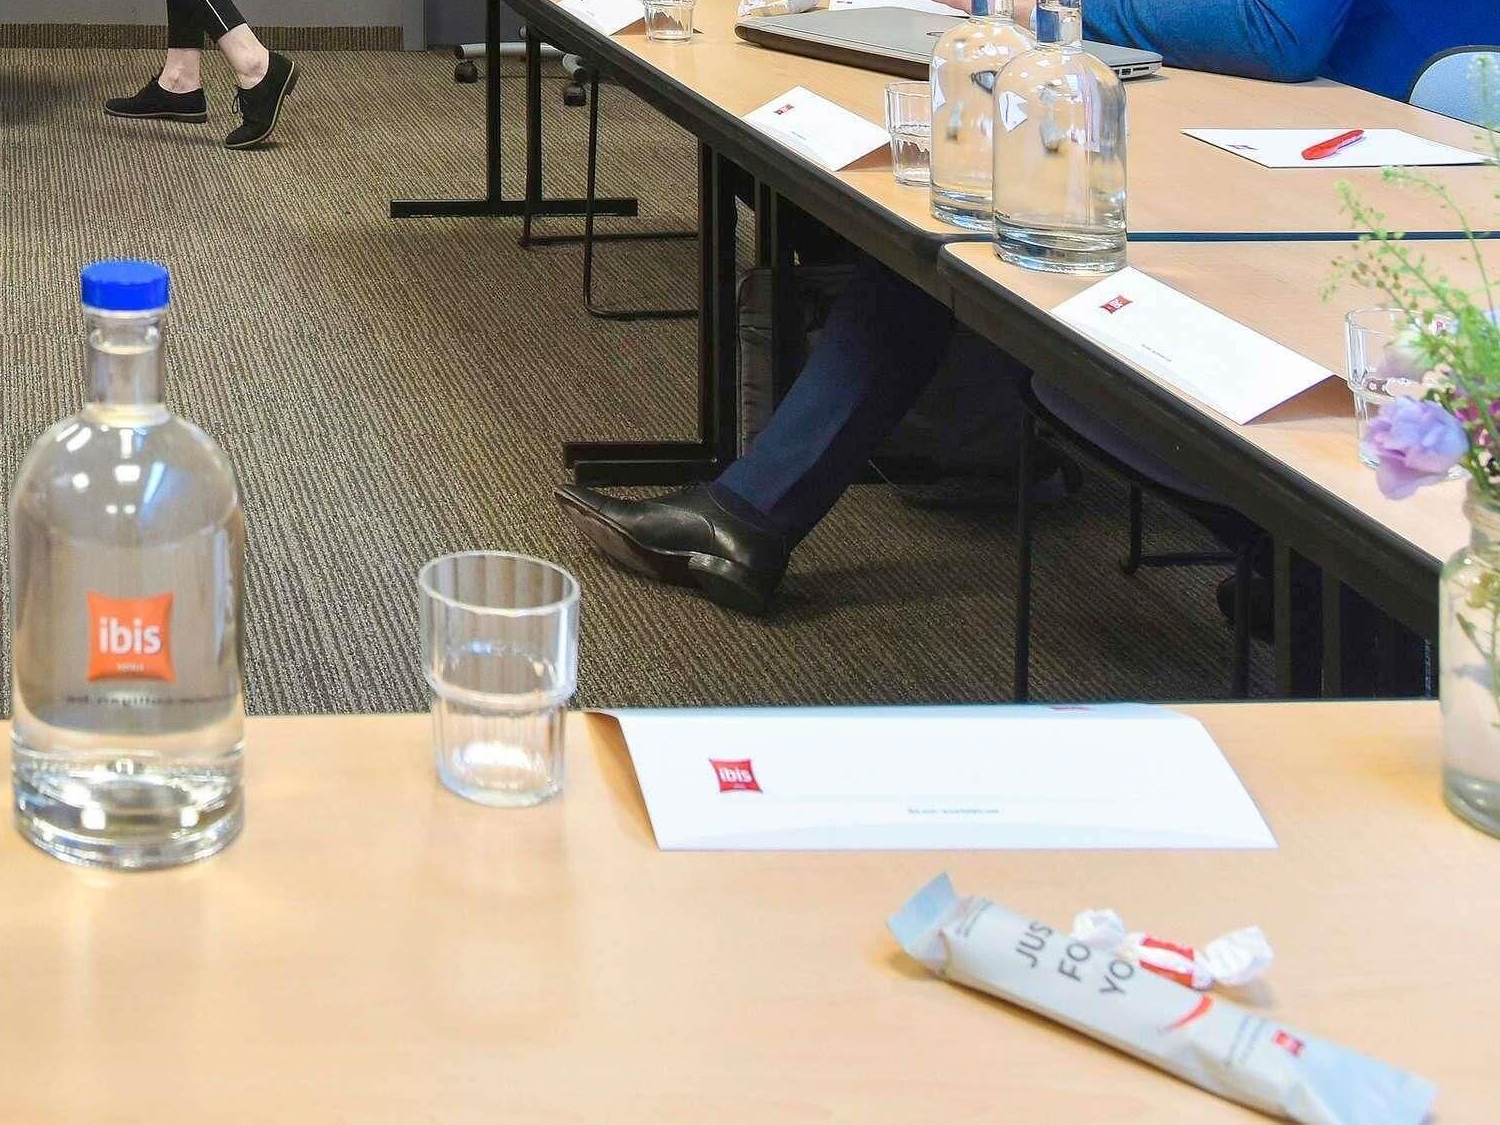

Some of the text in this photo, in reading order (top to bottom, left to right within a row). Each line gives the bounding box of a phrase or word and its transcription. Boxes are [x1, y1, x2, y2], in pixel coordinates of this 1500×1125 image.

[99, 617, 162, 655] ibis
[719, 767, 754, 782] ibis
[1016, 920, 1054, 968] JUS
[1058, 941, 1092, 982] FO
[1099, 959, 1136, 996] YO
